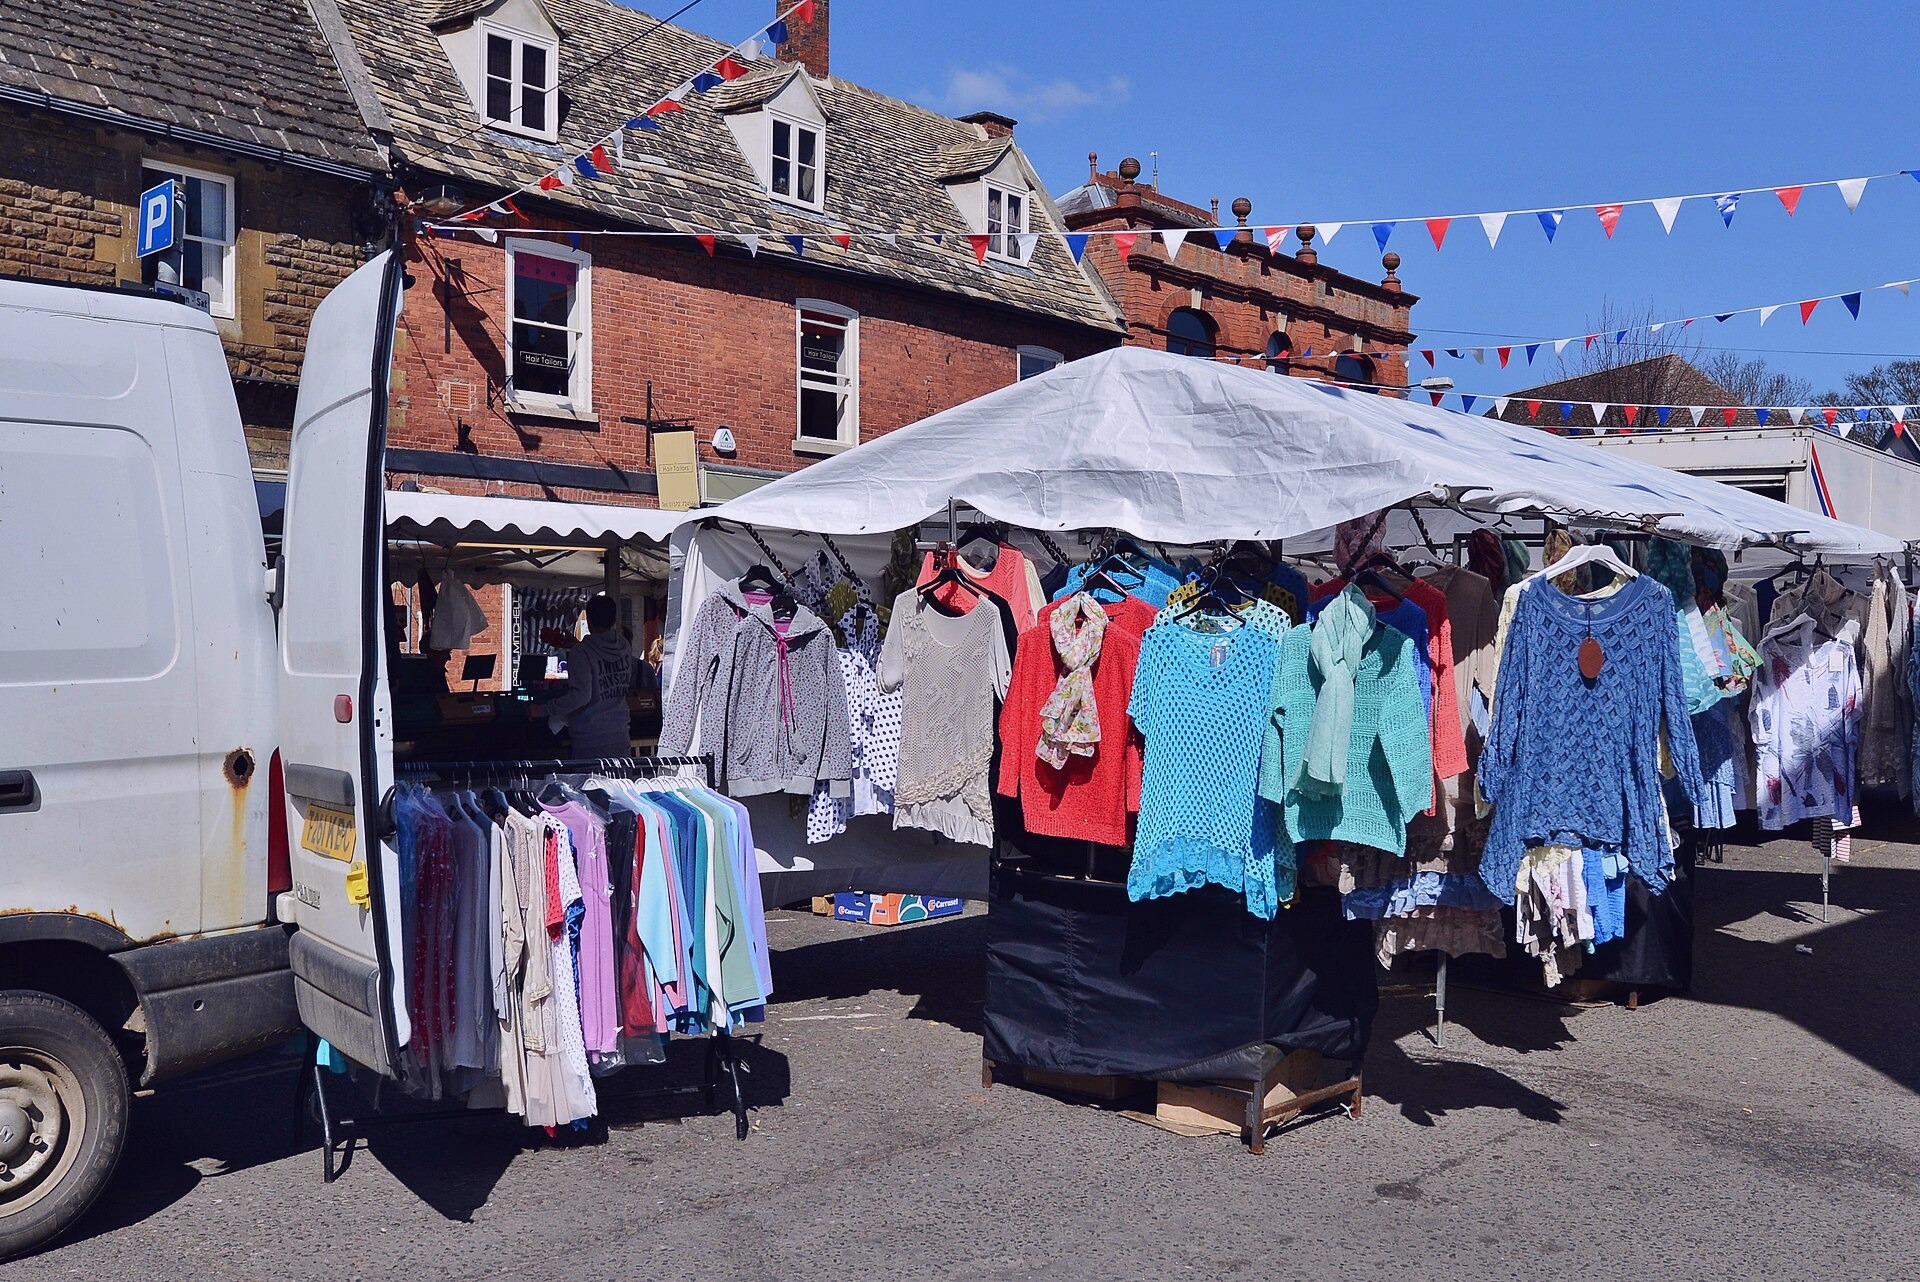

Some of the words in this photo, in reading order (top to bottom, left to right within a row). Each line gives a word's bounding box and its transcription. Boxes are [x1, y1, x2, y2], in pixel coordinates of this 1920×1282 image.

[145, 194, 167, 250] P
[196, 297, 208, 309] Sat
[525, 354, 540, 363] Hair
[541, 356, 563, 367] Tailors
